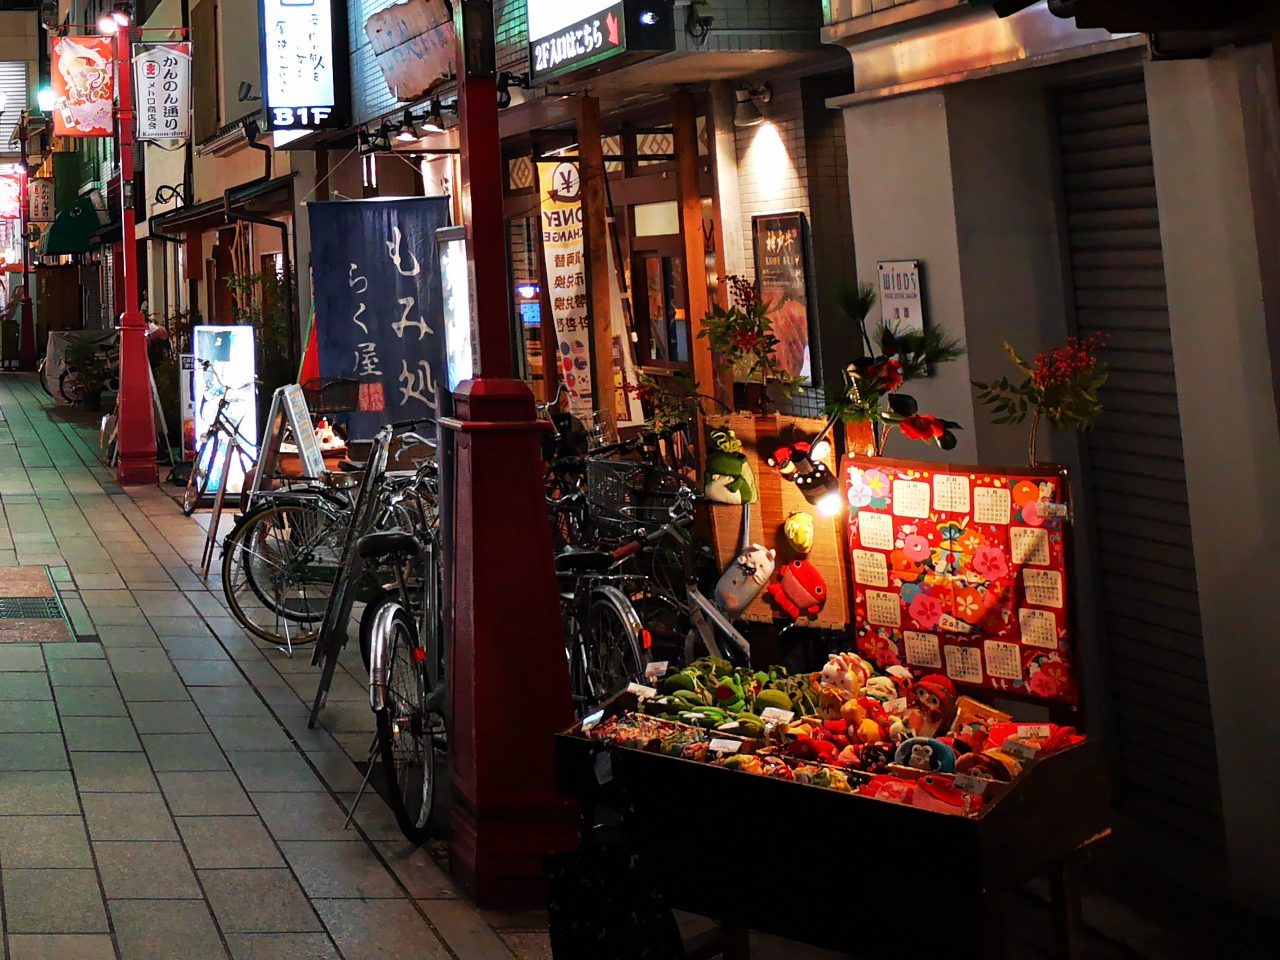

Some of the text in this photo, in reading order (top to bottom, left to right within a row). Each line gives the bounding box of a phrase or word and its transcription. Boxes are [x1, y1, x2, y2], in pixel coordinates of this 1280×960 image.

[535, 20, 604, 71] 2F入口はこちら
[163, 56, 179, 131] かんのん通り
[273, 107, 332, 126] B1F
[349, 263, 383, 377] らく屋
[386, 226, 436, 410] もみ処
